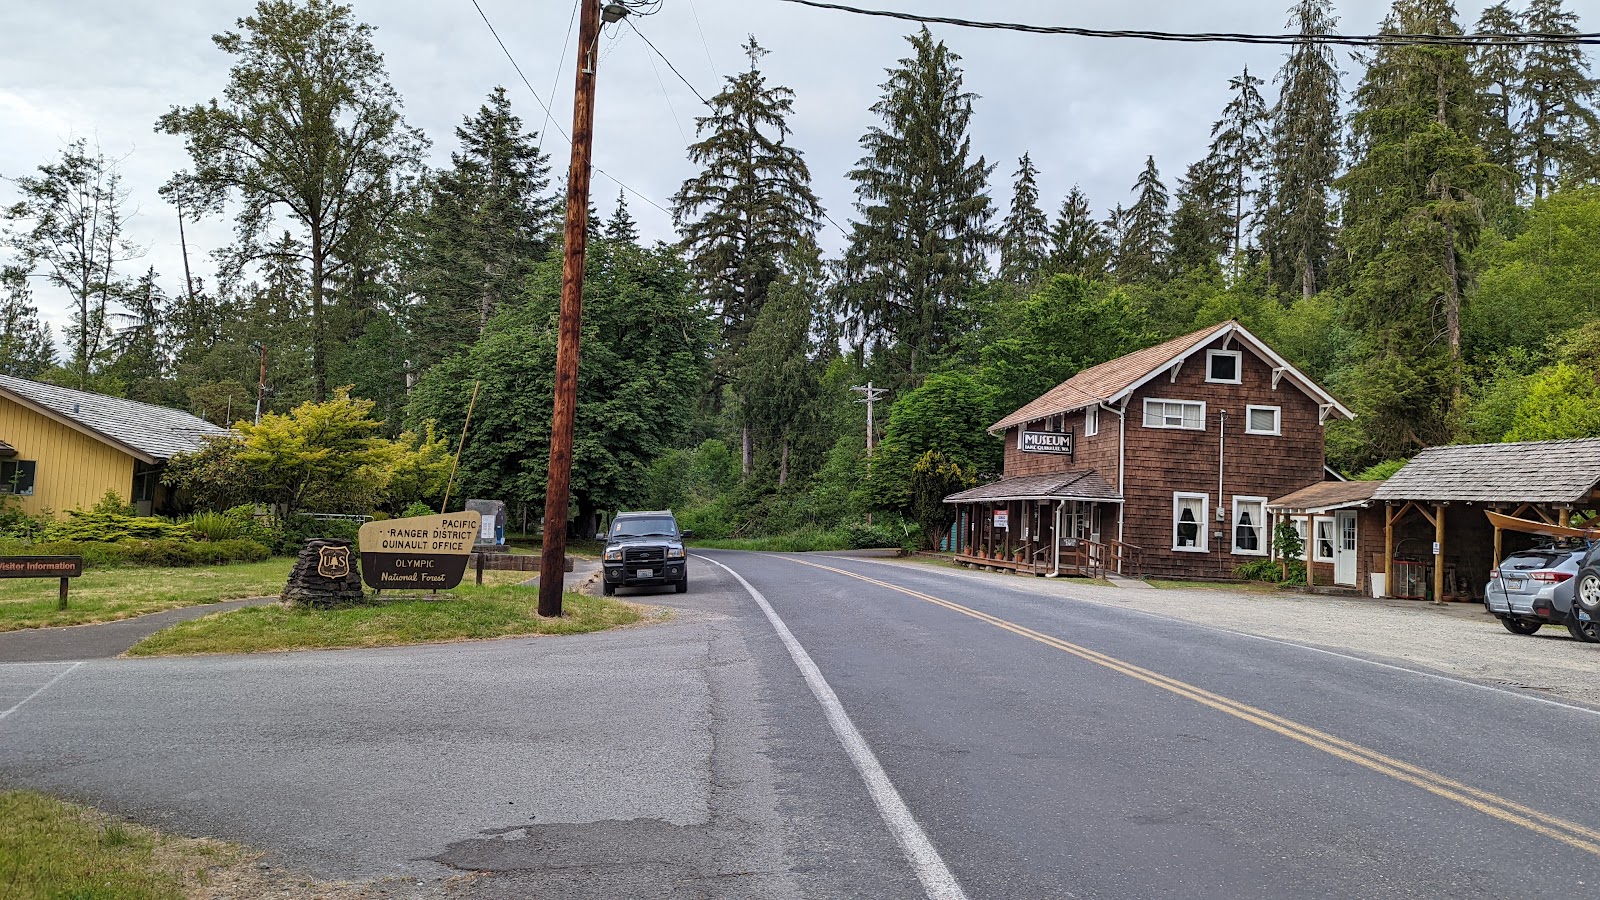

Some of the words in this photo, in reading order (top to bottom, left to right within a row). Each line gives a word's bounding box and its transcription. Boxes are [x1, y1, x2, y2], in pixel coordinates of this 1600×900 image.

[1025, 434, 1069, 446] MUSEUM
[442, 519, 477, 529] PACIFIC
[390, 528, 429, 538] RANGER
[432, 530, 472, 540] DISTRICT
[382, 540, 428, 550] QUINAULT
[432, 541, 463, 551] OFFICE
[26, 561, 76, 570] Information
[395, 558, 434, 568] OLYMPIC
[381, 571, 417, 582] National
[421, 572, 446, 583] Forest
